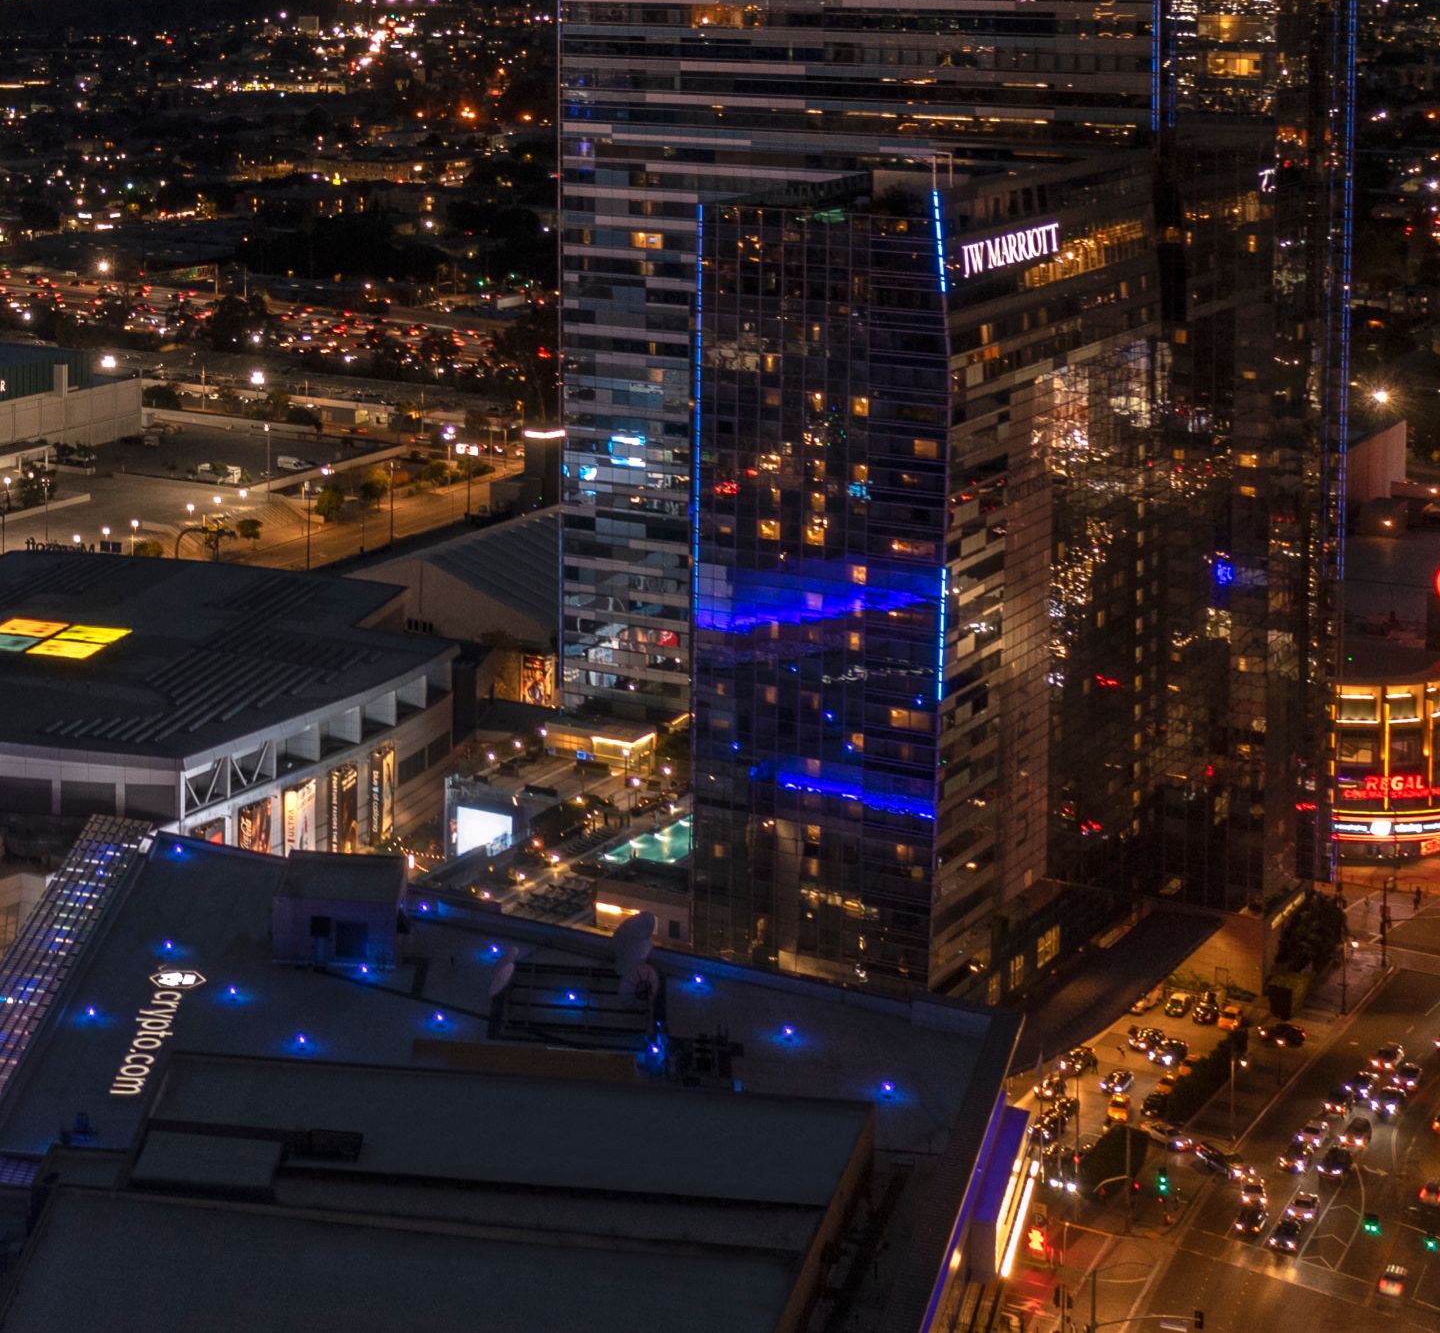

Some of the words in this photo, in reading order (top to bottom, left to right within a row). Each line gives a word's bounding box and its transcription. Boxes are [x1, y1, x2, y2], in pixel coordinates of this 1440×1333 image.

[962, 242, 984, 278] JW
[985, 222, 1059, 269] MARRIOTT
[1365, 775, 1425, 791] REGAL
[109, 991, 182, 1094] crypto.com
